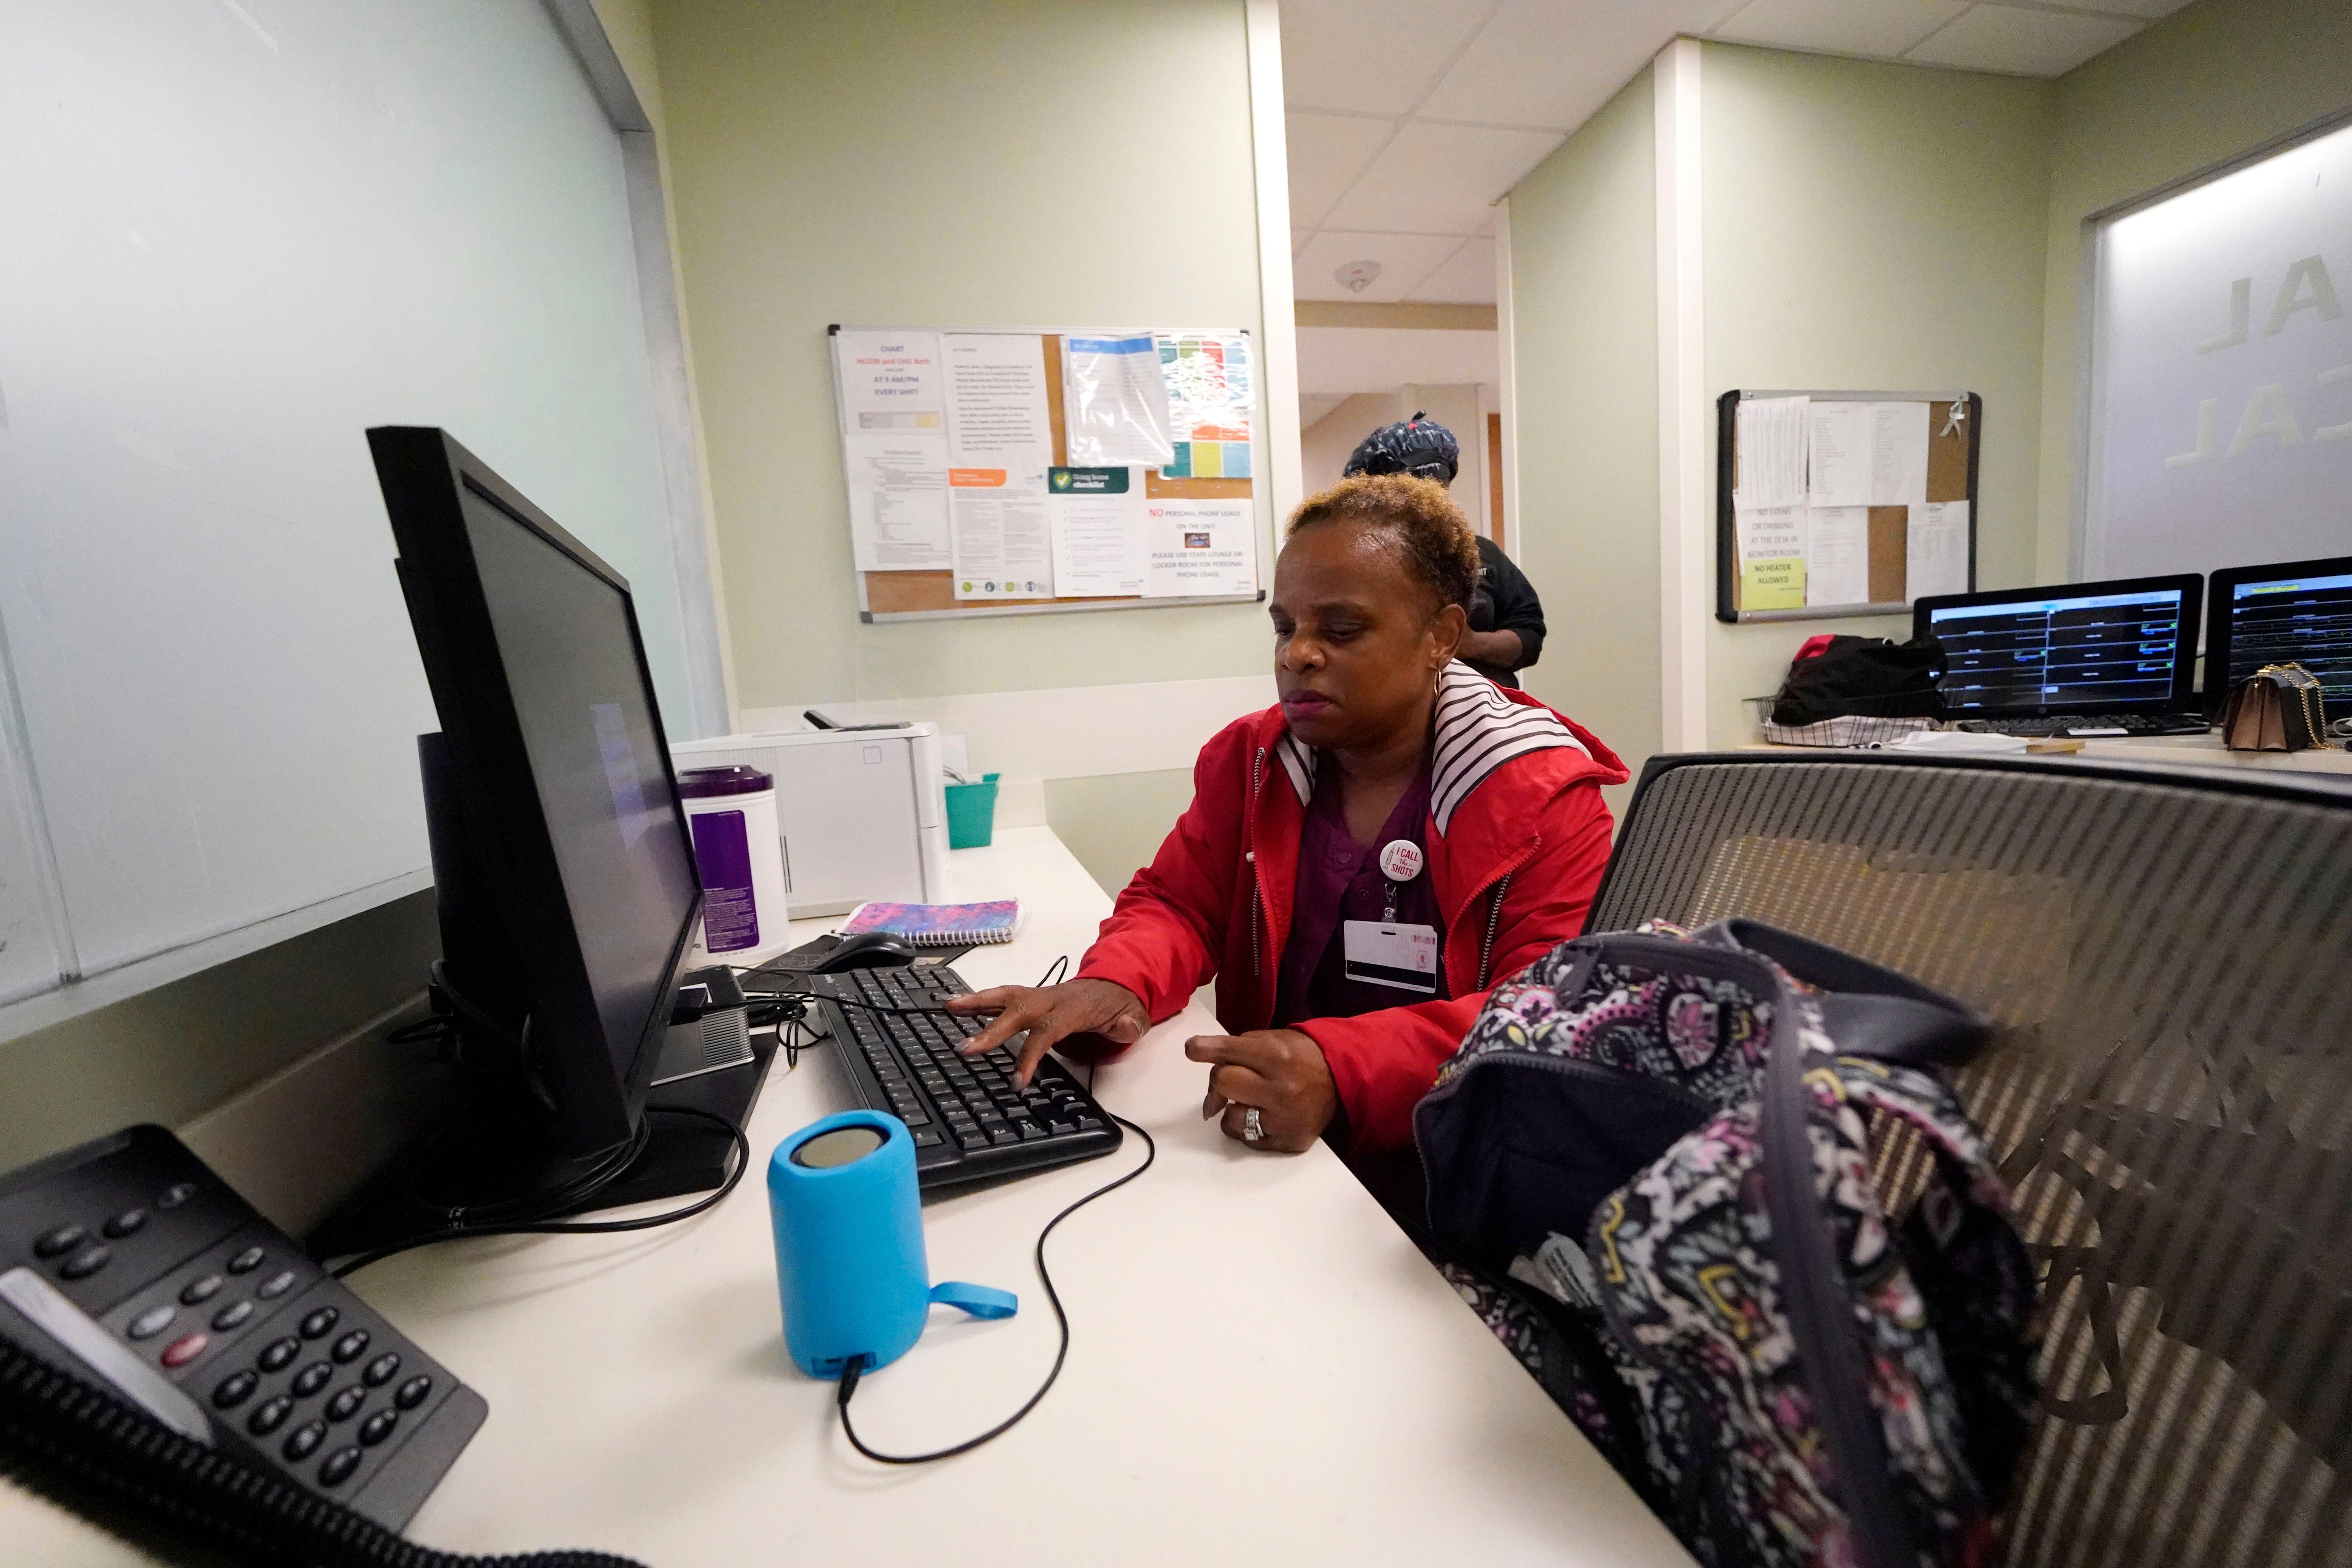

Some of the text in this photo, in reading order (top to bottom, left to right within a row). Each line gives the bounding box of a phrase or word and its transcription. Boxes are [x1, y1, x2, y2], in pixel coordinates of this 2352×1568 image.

[1396, 847, 1418, 862] I CALL
[1391, 864, 1414, 877] SHOTS
